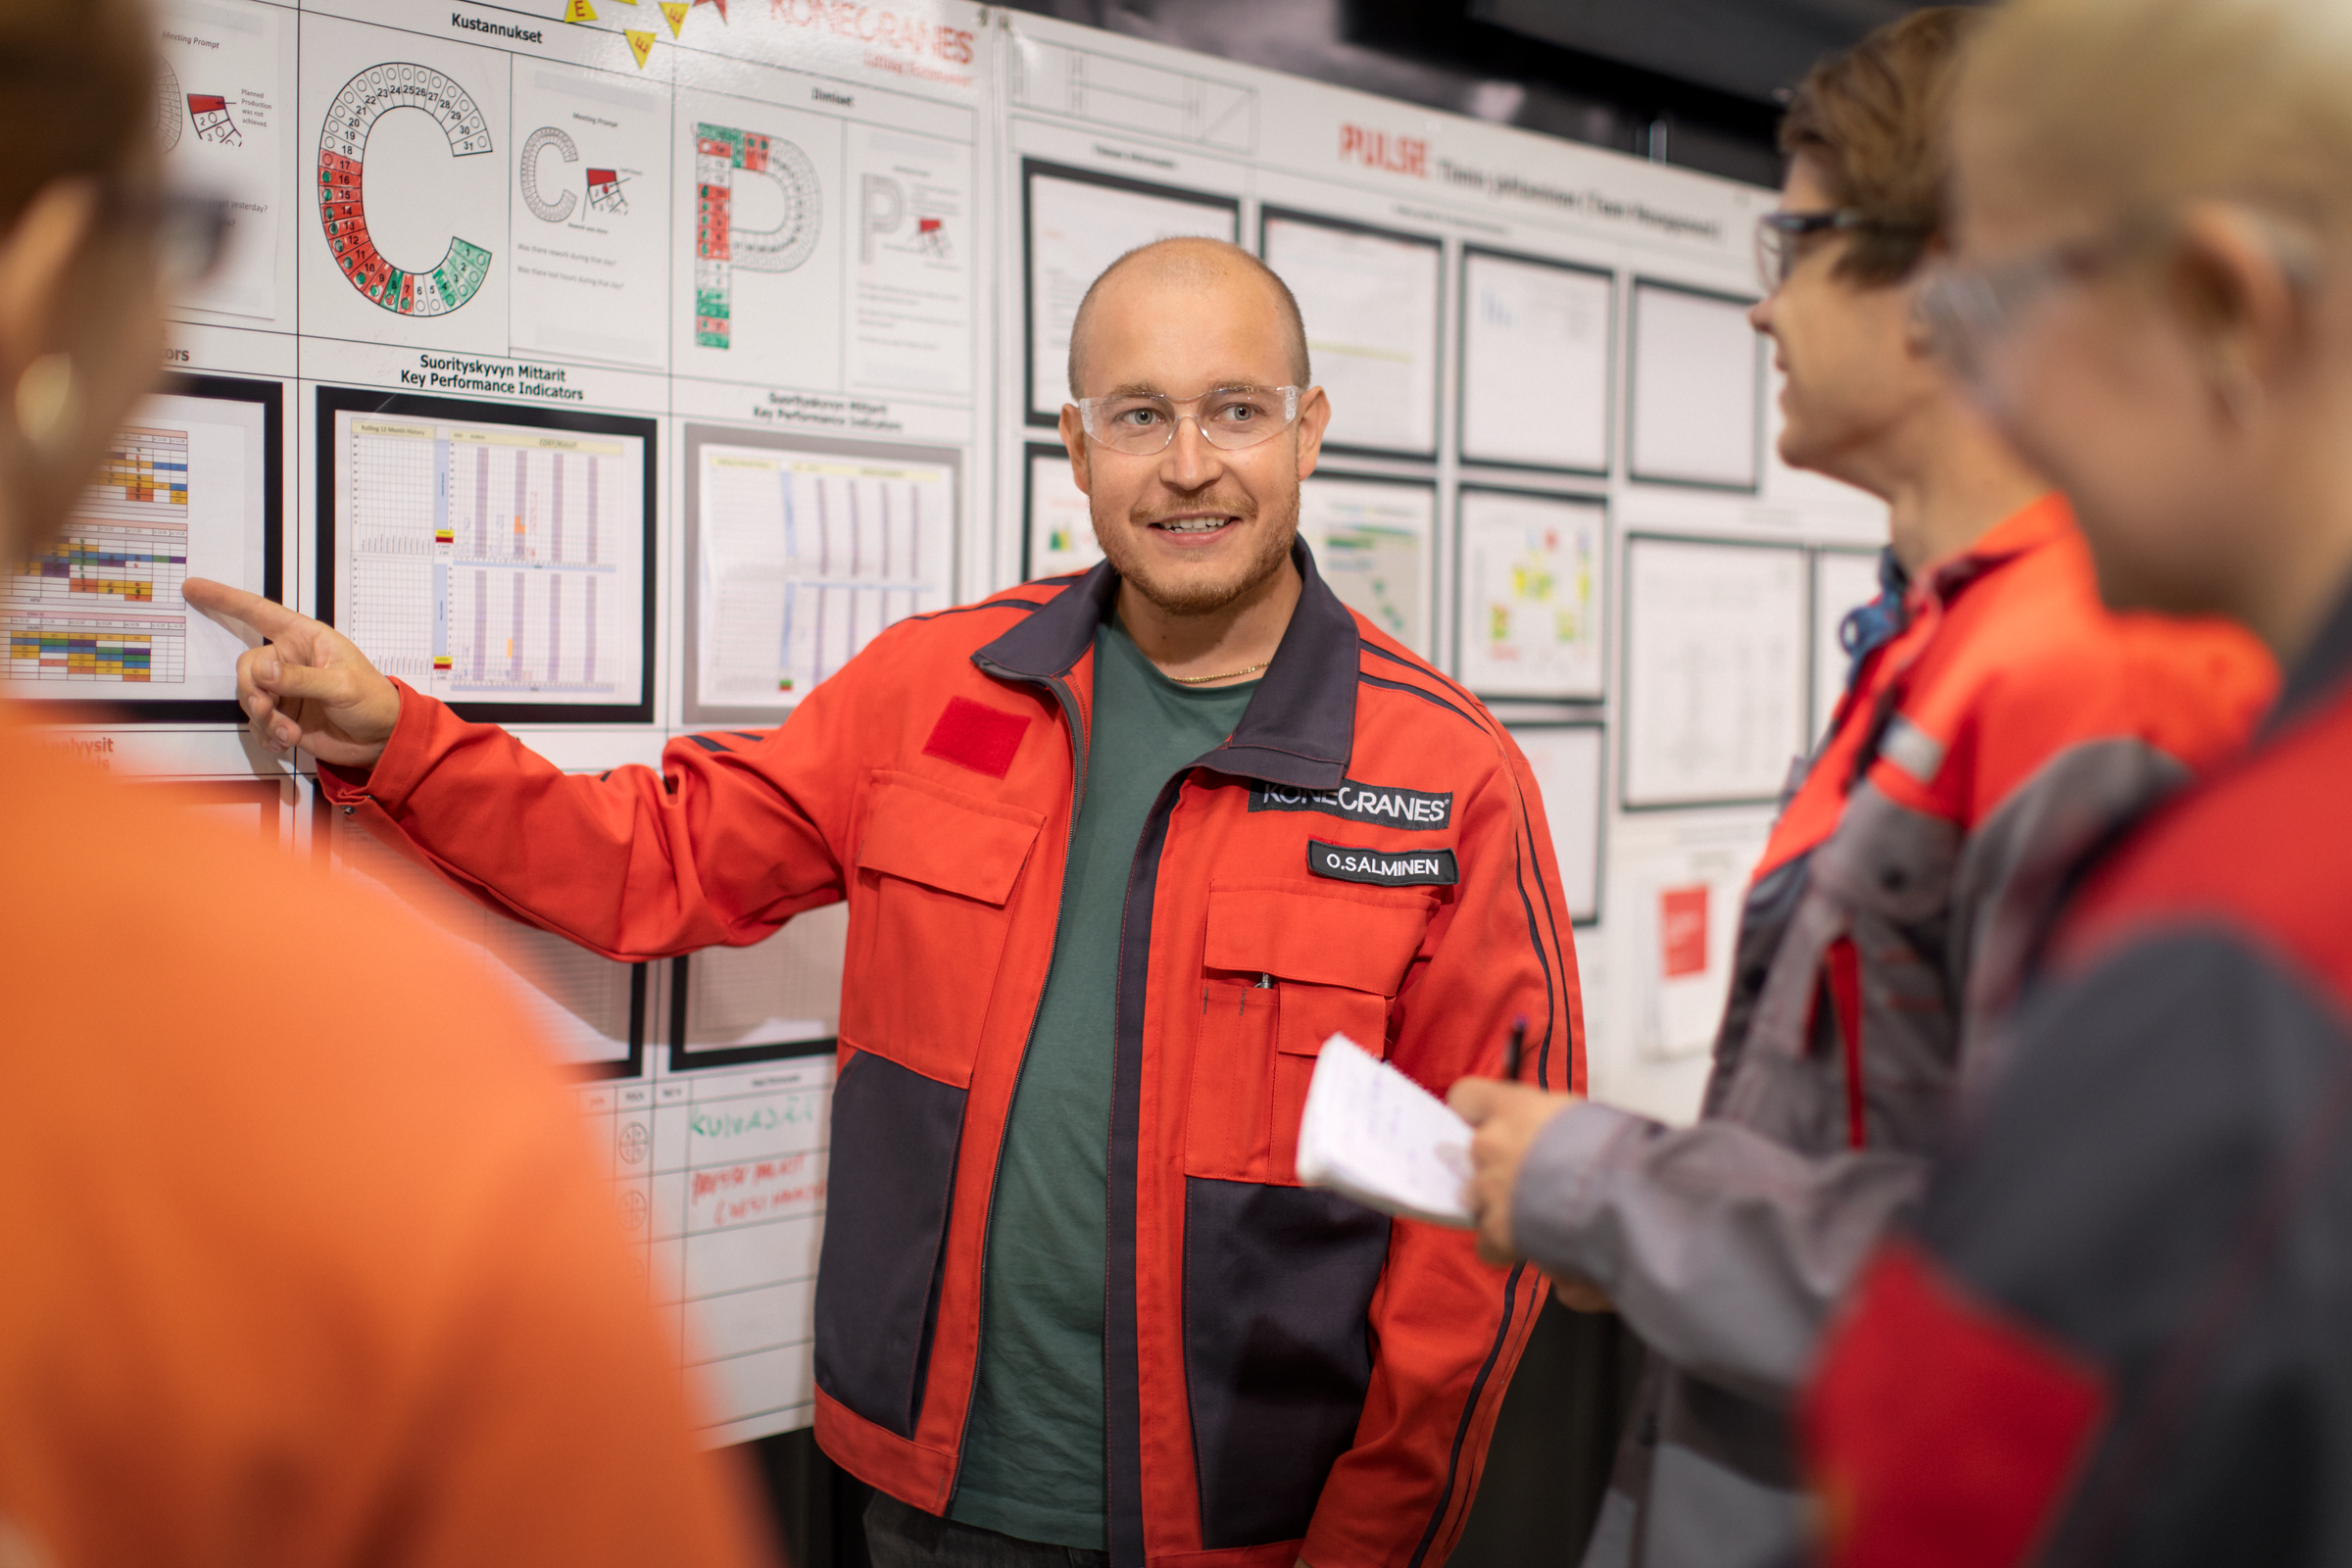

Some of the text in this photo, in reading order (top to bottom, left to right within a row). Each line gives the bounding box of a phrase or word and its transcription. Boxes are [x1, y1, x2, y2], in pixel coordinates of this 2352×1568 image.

[452, 13, 542, 44] Kustannukset
[162, 30, 220, 49] Meeting Prompt
[377, 88, 388, 98] 23
[390, 85, 401, 95] 24
[403, 85, 415, 94] 25
[416, 87, 426, 97] 26
[365, 95, 376, 105] 22
[428, 92, 438, 102] 27
[241, 99, 271, 110] Production
[440, 99, 451, 109] 28
[356, 106, 367, 116] 21
[451, 110, 461, 121] 29
[349, 118, 360, 127] 20
[345, 130, 355, 140] 19
[460, 125, 469, 135] 30
[342, 145, 353, 155] 18
[464, 141, 473, 151] 31
[339, 160, 350, 170] 17
[339, 174, 350, 184] 16
[339, 190, 350, 199] 15
[230, 200, 268, 214] yesterday?
[342, 206, 352, 216] 14
[344, 221, 355, 230] 13
[348, 235, 359, 245] 12
[356, 250, 366, 259] 11
[466, 248, 470, 257] 1
[365, 263, 374, 272] 10
[461, 263, 466, 271] 2
[378, 273, 384, 282] 9
[453, 274, 459, 283] 3
[405, 284, 410, 293] 7
[416, 286, 422, 295] 6
[429, 285, 435, 294] 5
[419, 354, 565, 382] Suorityskyvyn Mittarit
[401, 369, 584, 401] Key Performance Indicators
[1326, 853, 1439, 876] O.SALMINEN
